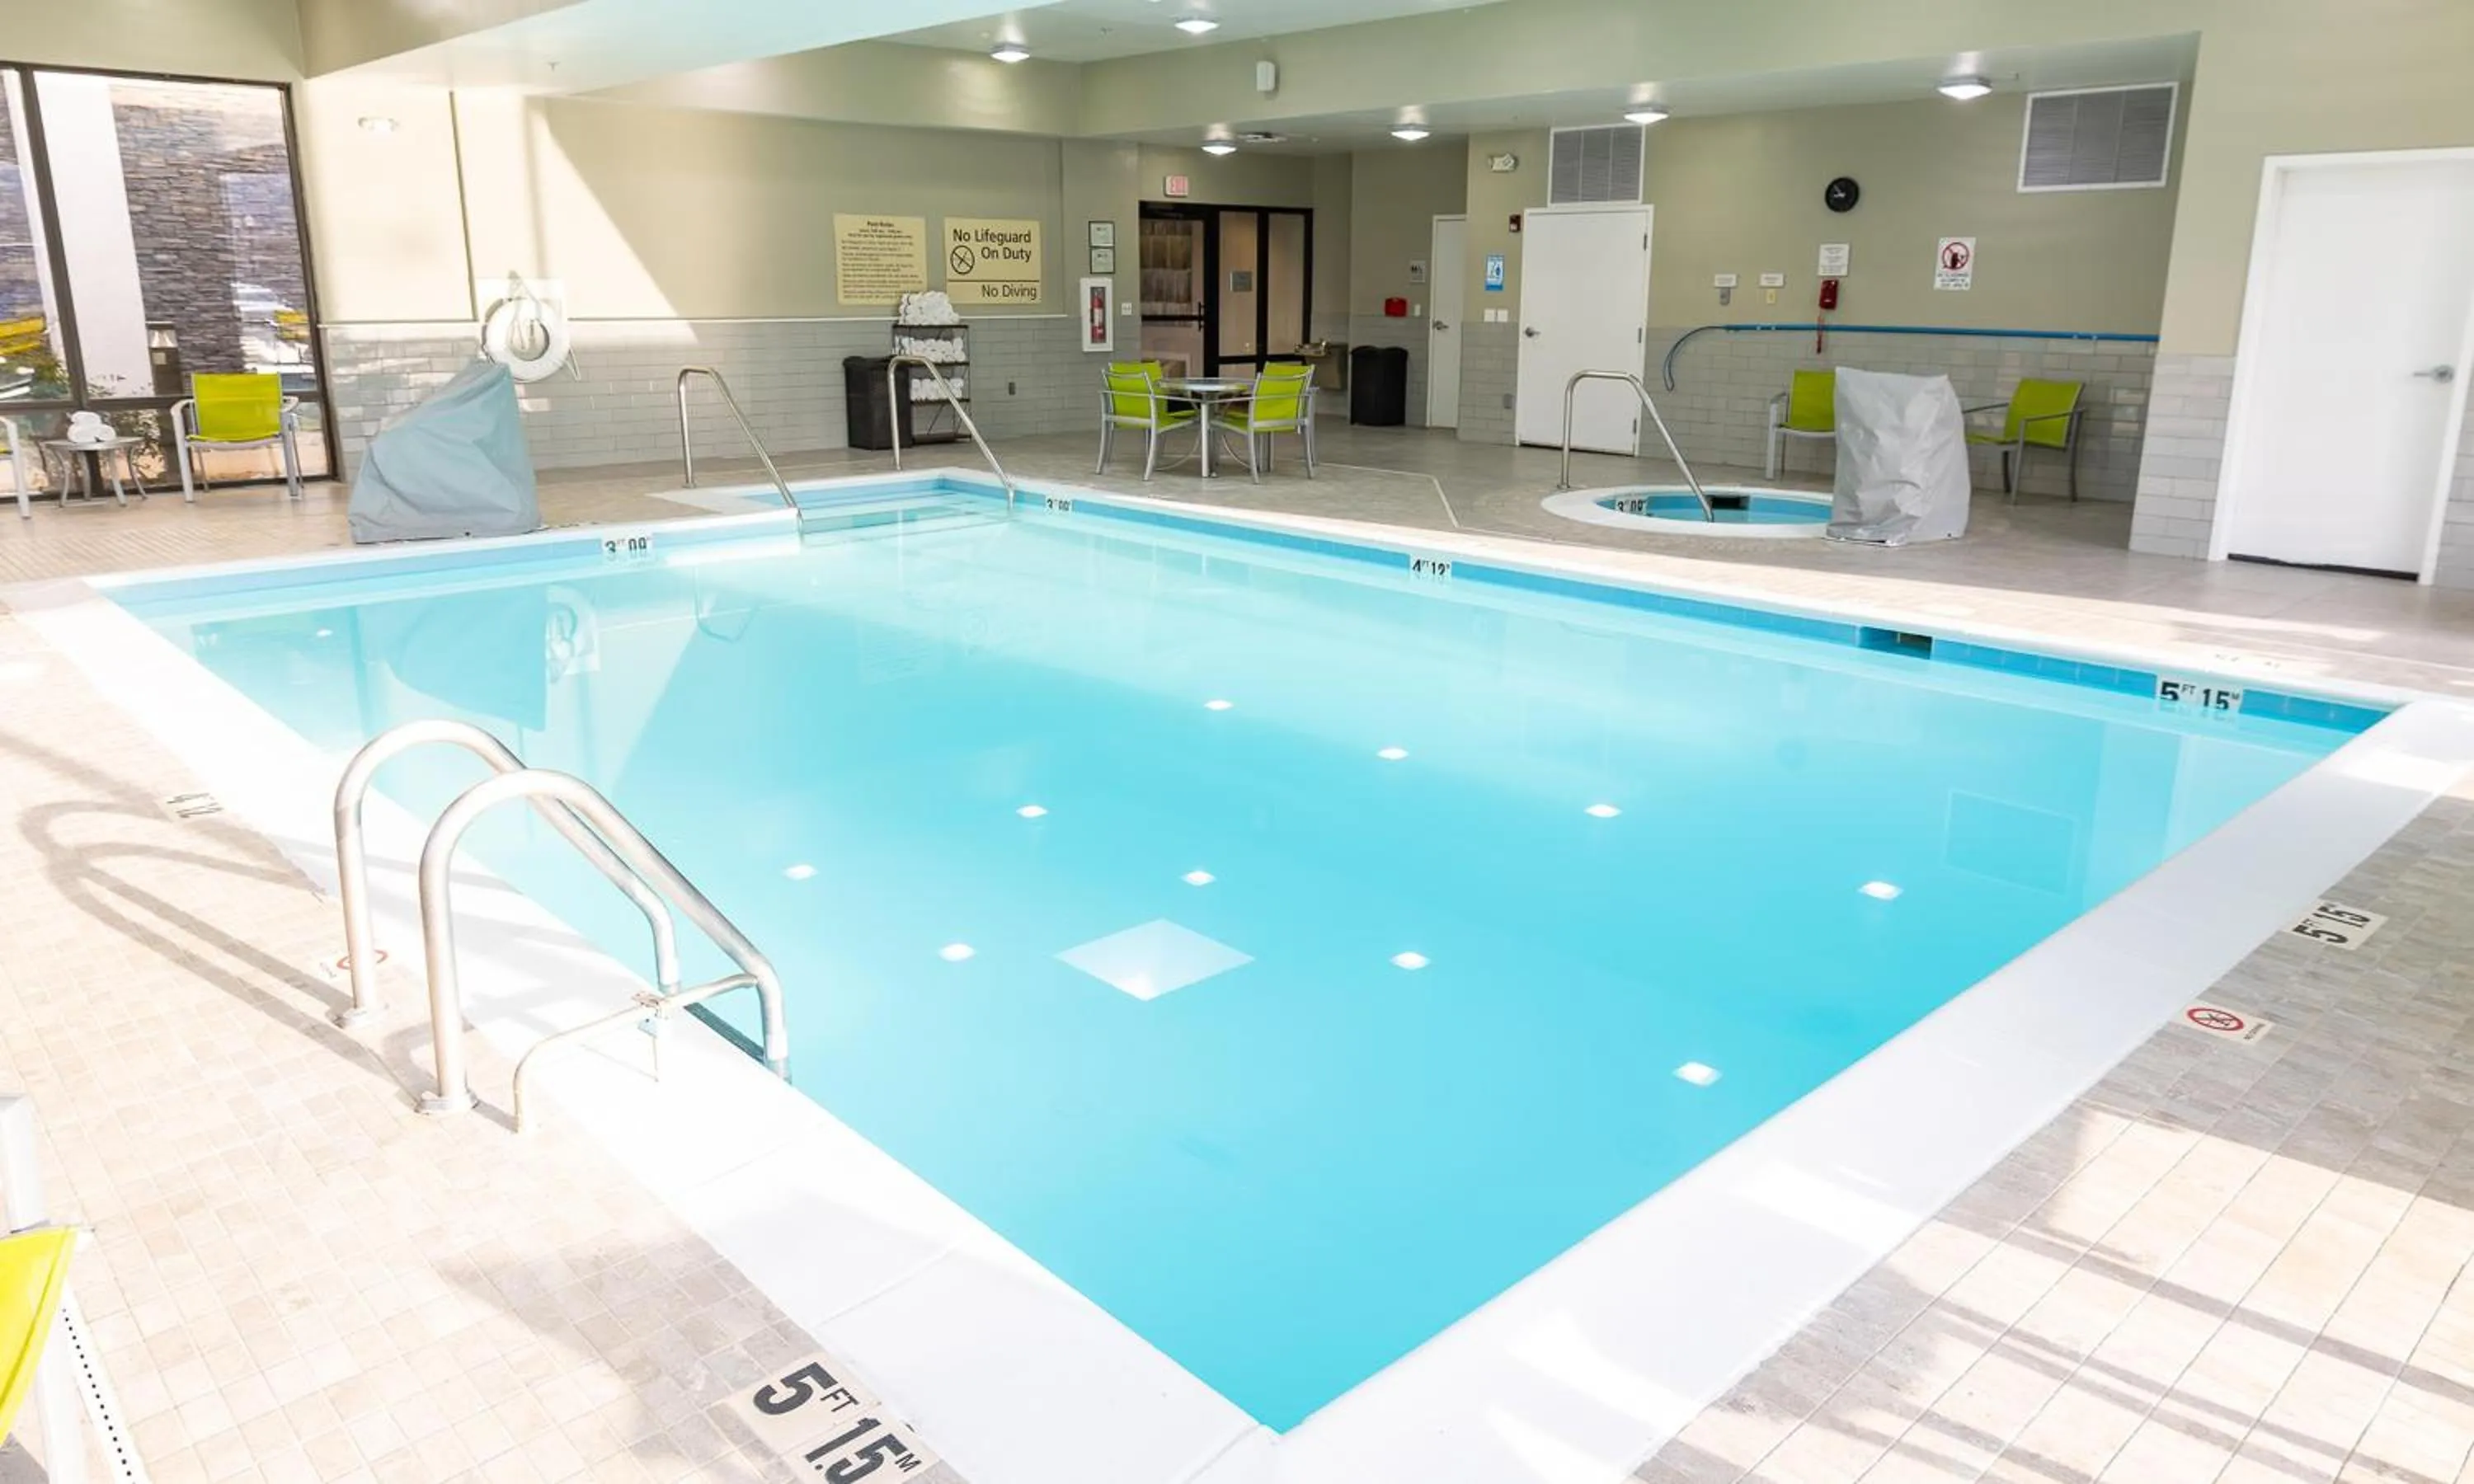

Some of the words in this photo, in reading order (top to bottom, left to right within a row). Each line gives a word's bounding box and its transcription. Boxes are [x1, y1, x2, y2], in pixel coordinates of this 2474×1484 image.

[953, 229, 971, 242] No
[975, 228, 1031, 246] Lifeguard
[981, 247, 999, 259] On
[1003, 247, 1032, 263] Duty
[982, 284, 999, 297] No
[1003, 284, 1037, 300] Diving
